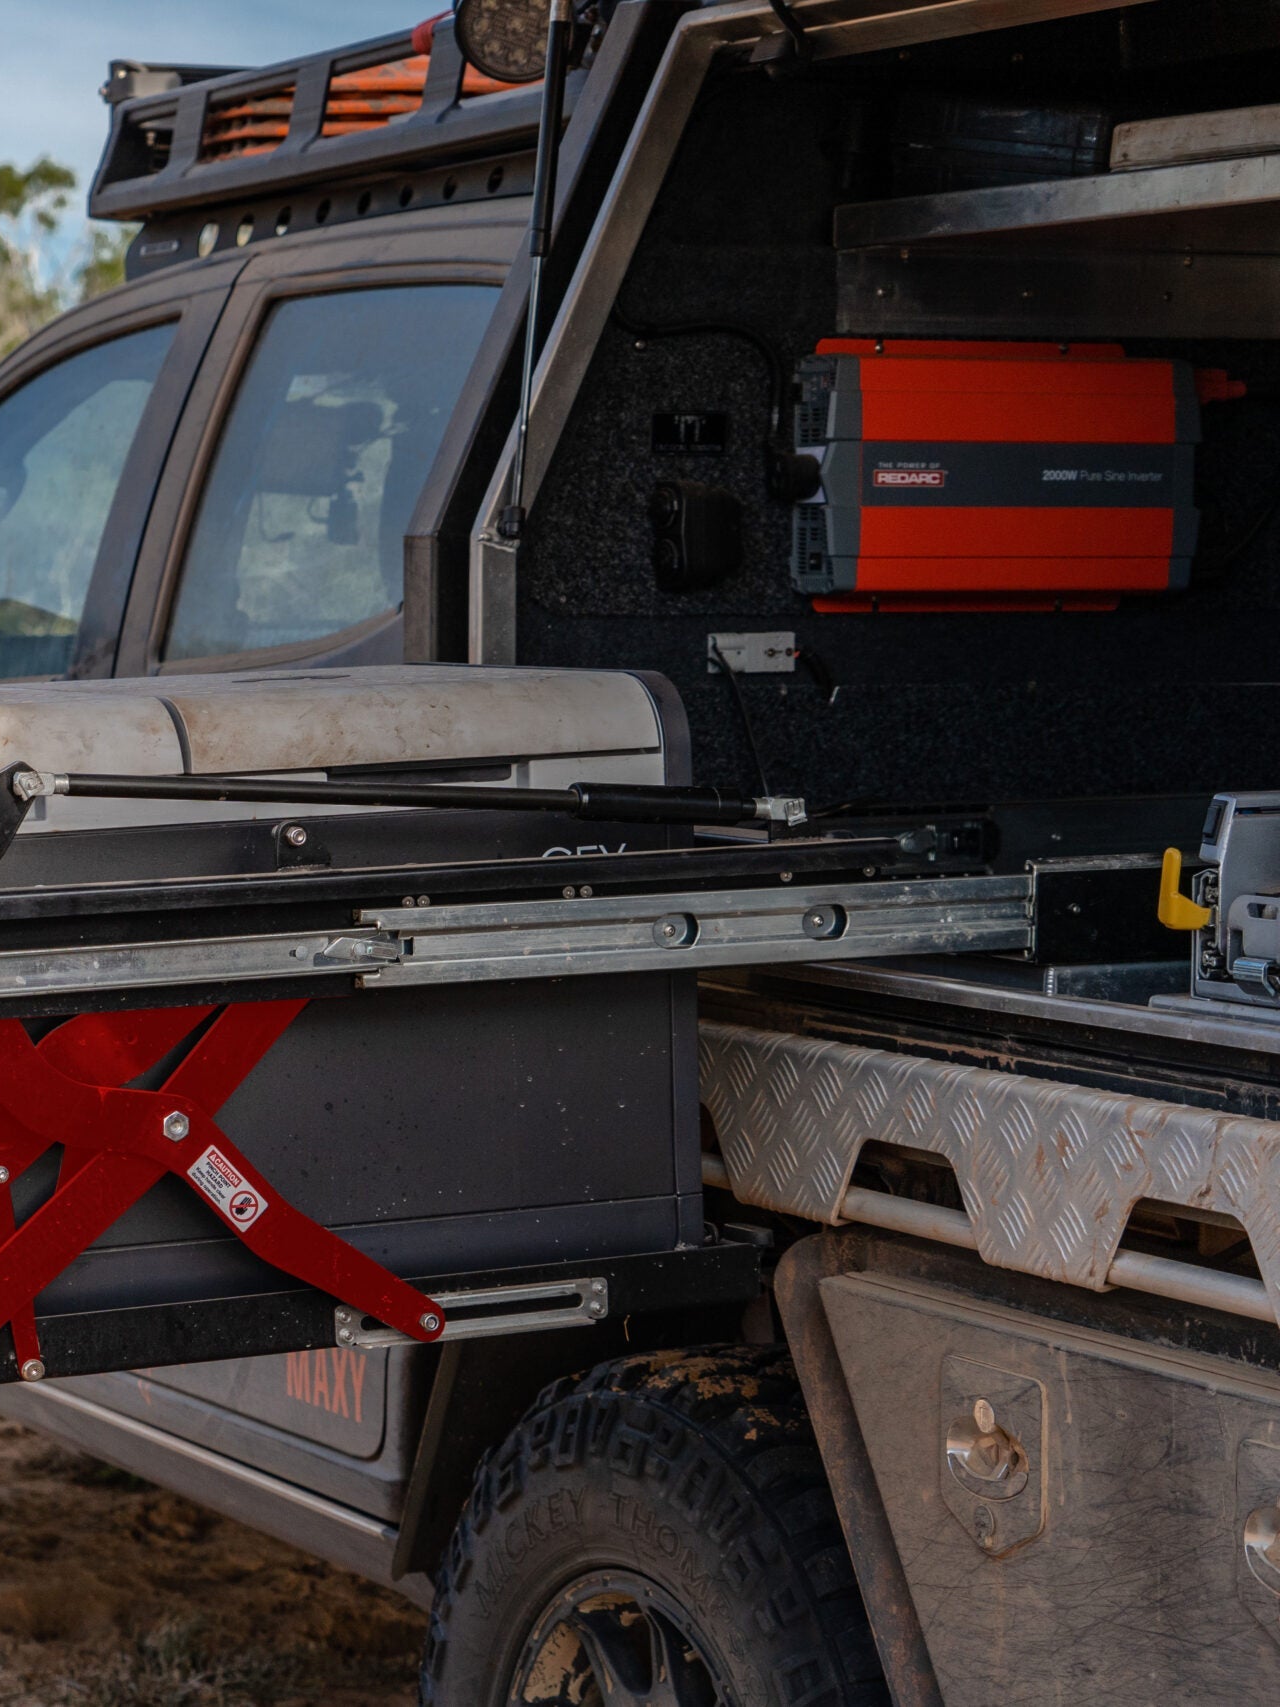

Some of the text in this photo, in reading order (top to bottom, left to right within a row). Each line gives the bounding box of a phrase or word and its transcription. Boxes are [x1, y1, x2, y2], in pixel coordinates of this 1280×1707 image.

[896, 461, 927, 469] POWER
[929, 461, 942, 469] OF
[1041, 469, 1165, 482] 2000W Pure Sine Inverter
[877, 473, 942, 485] REDARC
[205, 1169, 224, 1188] HAZARD
[206, 1161, 231, 1188] PINCH POINT
[215, 1158, 240, 1186] CAUTION
[286, 1347, 366, 1424] MAXY
[470, 1486, 587, 1618] MICKEY
